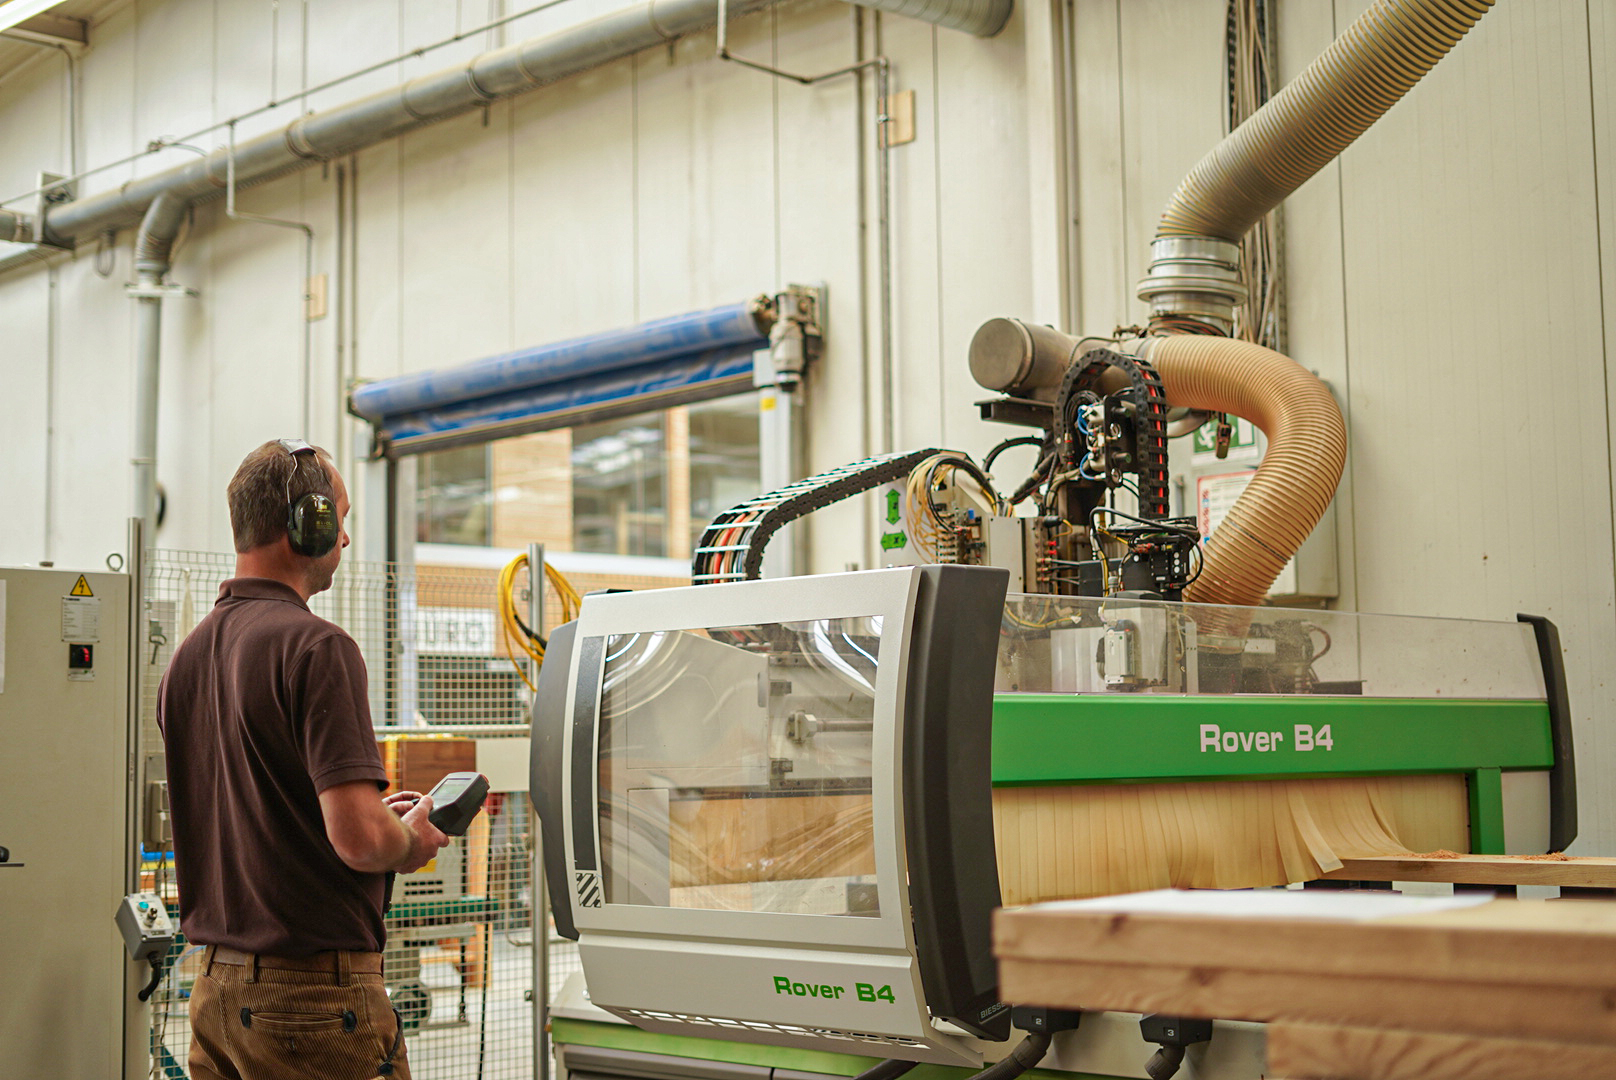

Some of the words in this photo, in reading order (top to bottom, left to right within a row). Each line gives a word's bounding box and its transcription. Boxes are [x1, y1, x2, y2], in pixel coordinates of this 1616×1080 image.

[1200, 724, 1283, 752] Rover
[1294, 724, 1333, 751] B4
[773, 976, 845, 999] Rover
[855, 982, 896, 1004] B4
[1035, 1017, 1042, 1026] 2
[1167, 1029, 1175, 1037] 3
